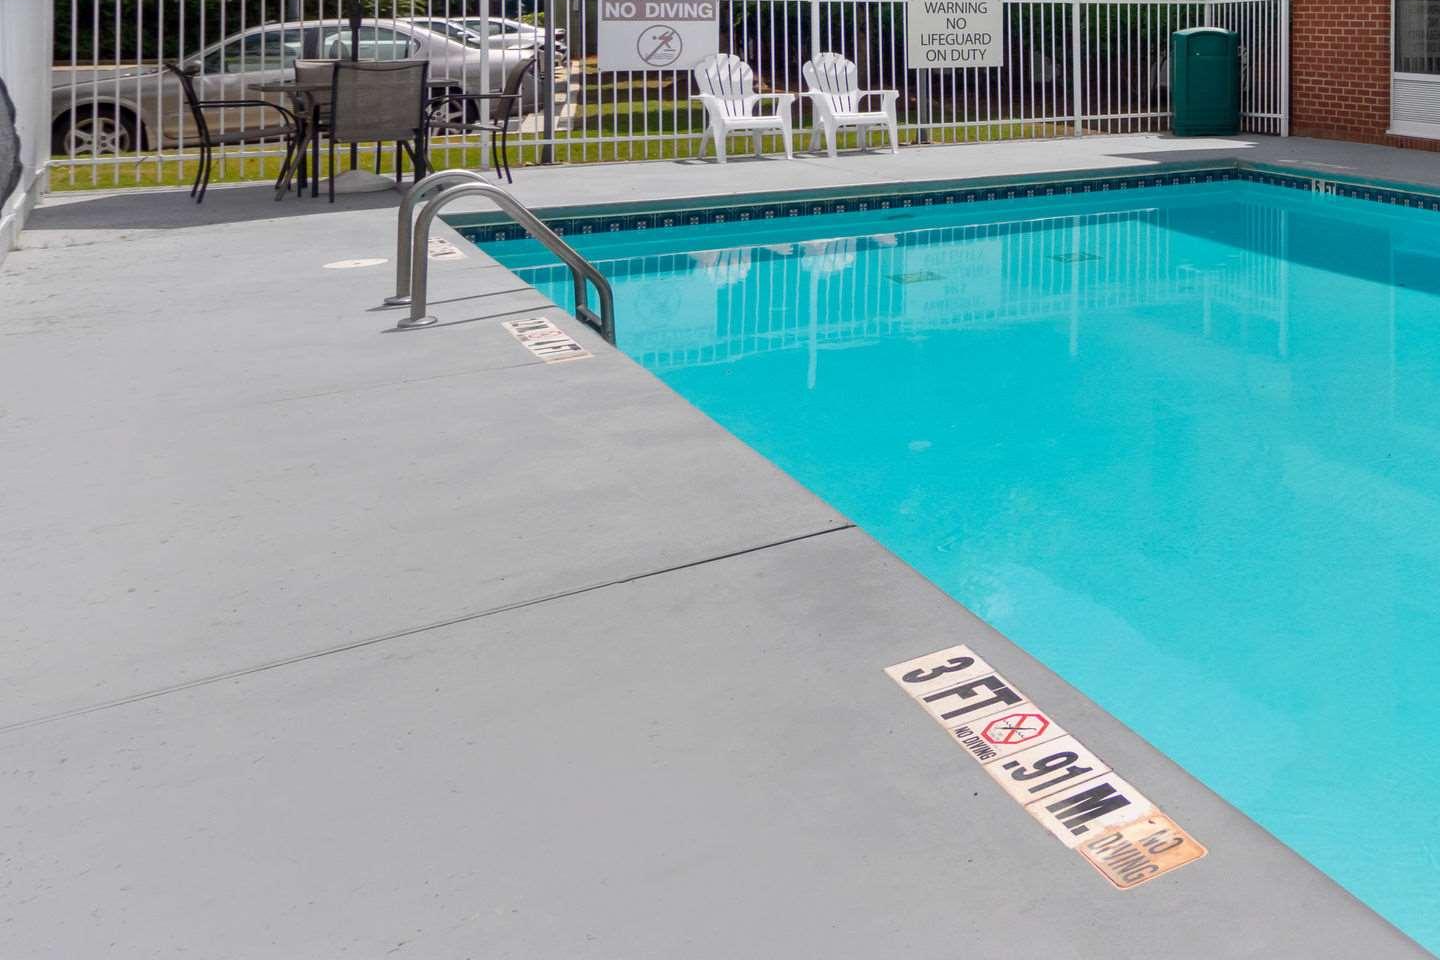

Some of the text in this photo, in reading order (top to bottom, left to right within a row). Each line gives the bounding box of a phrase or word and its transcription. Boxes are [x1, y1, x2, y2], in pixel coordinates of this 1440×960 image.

[605, 2, 714, 18] NO DIVING
[924, 0, 988, 16] WARNING
[946, 17, 967, 30] NO
[920, 32, 992, 47] LIFEGUARD
[926, 48, 987, 62] ON DUTY
[902, 656, 1024, 721] 3 FT
[955, 726, 997, 761] NO DIVING
[1087, 831, 1160, 883] DIVING
